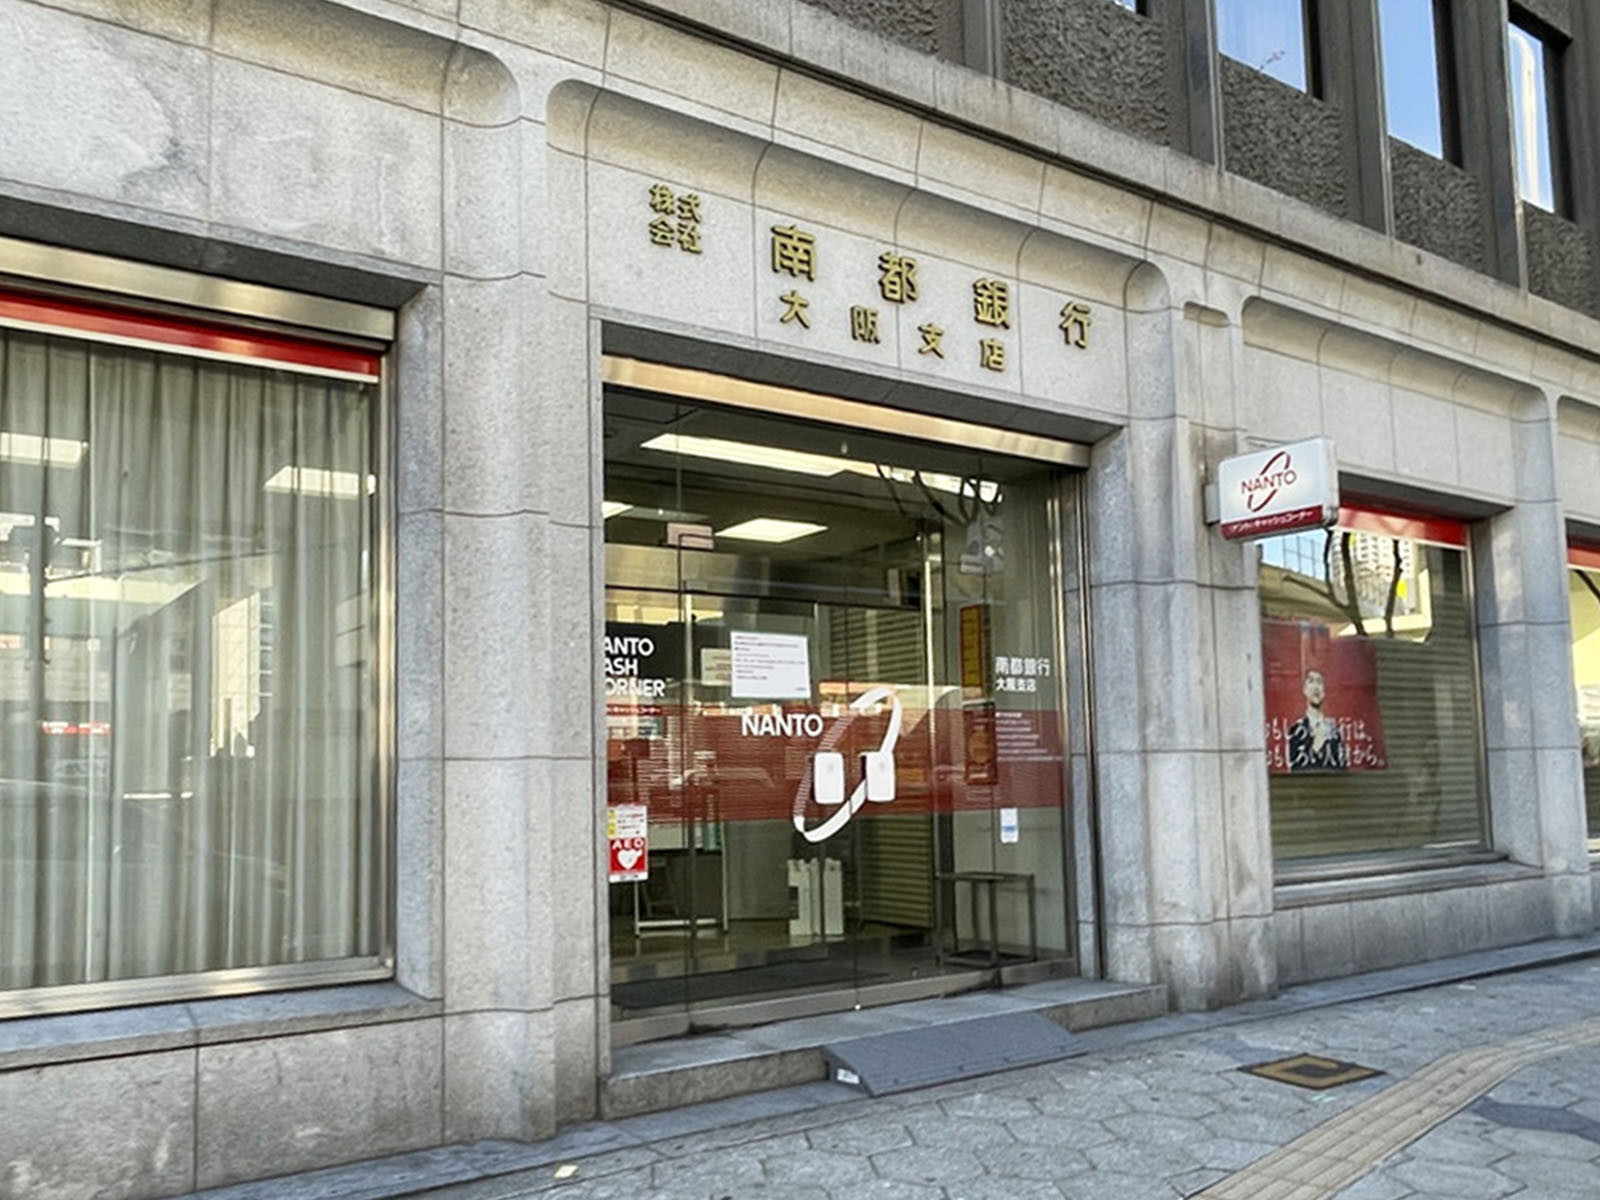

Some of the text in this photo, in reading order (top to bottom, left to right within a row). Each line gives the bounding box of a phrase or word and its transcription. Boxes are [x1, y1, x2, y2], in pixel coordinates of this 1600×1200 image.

[771, 224, 1093, 349] 南都銀行
[780, 289, 1006, 371] 大阪支店
[1241, 469, 1297, 494] NANTO
[604, 637, 655, 656] ANTO
[604, 657, 639, 676] ASH
[605, 677, 665, 697] ORNER
[741, 714, 823, 737] NANTO
